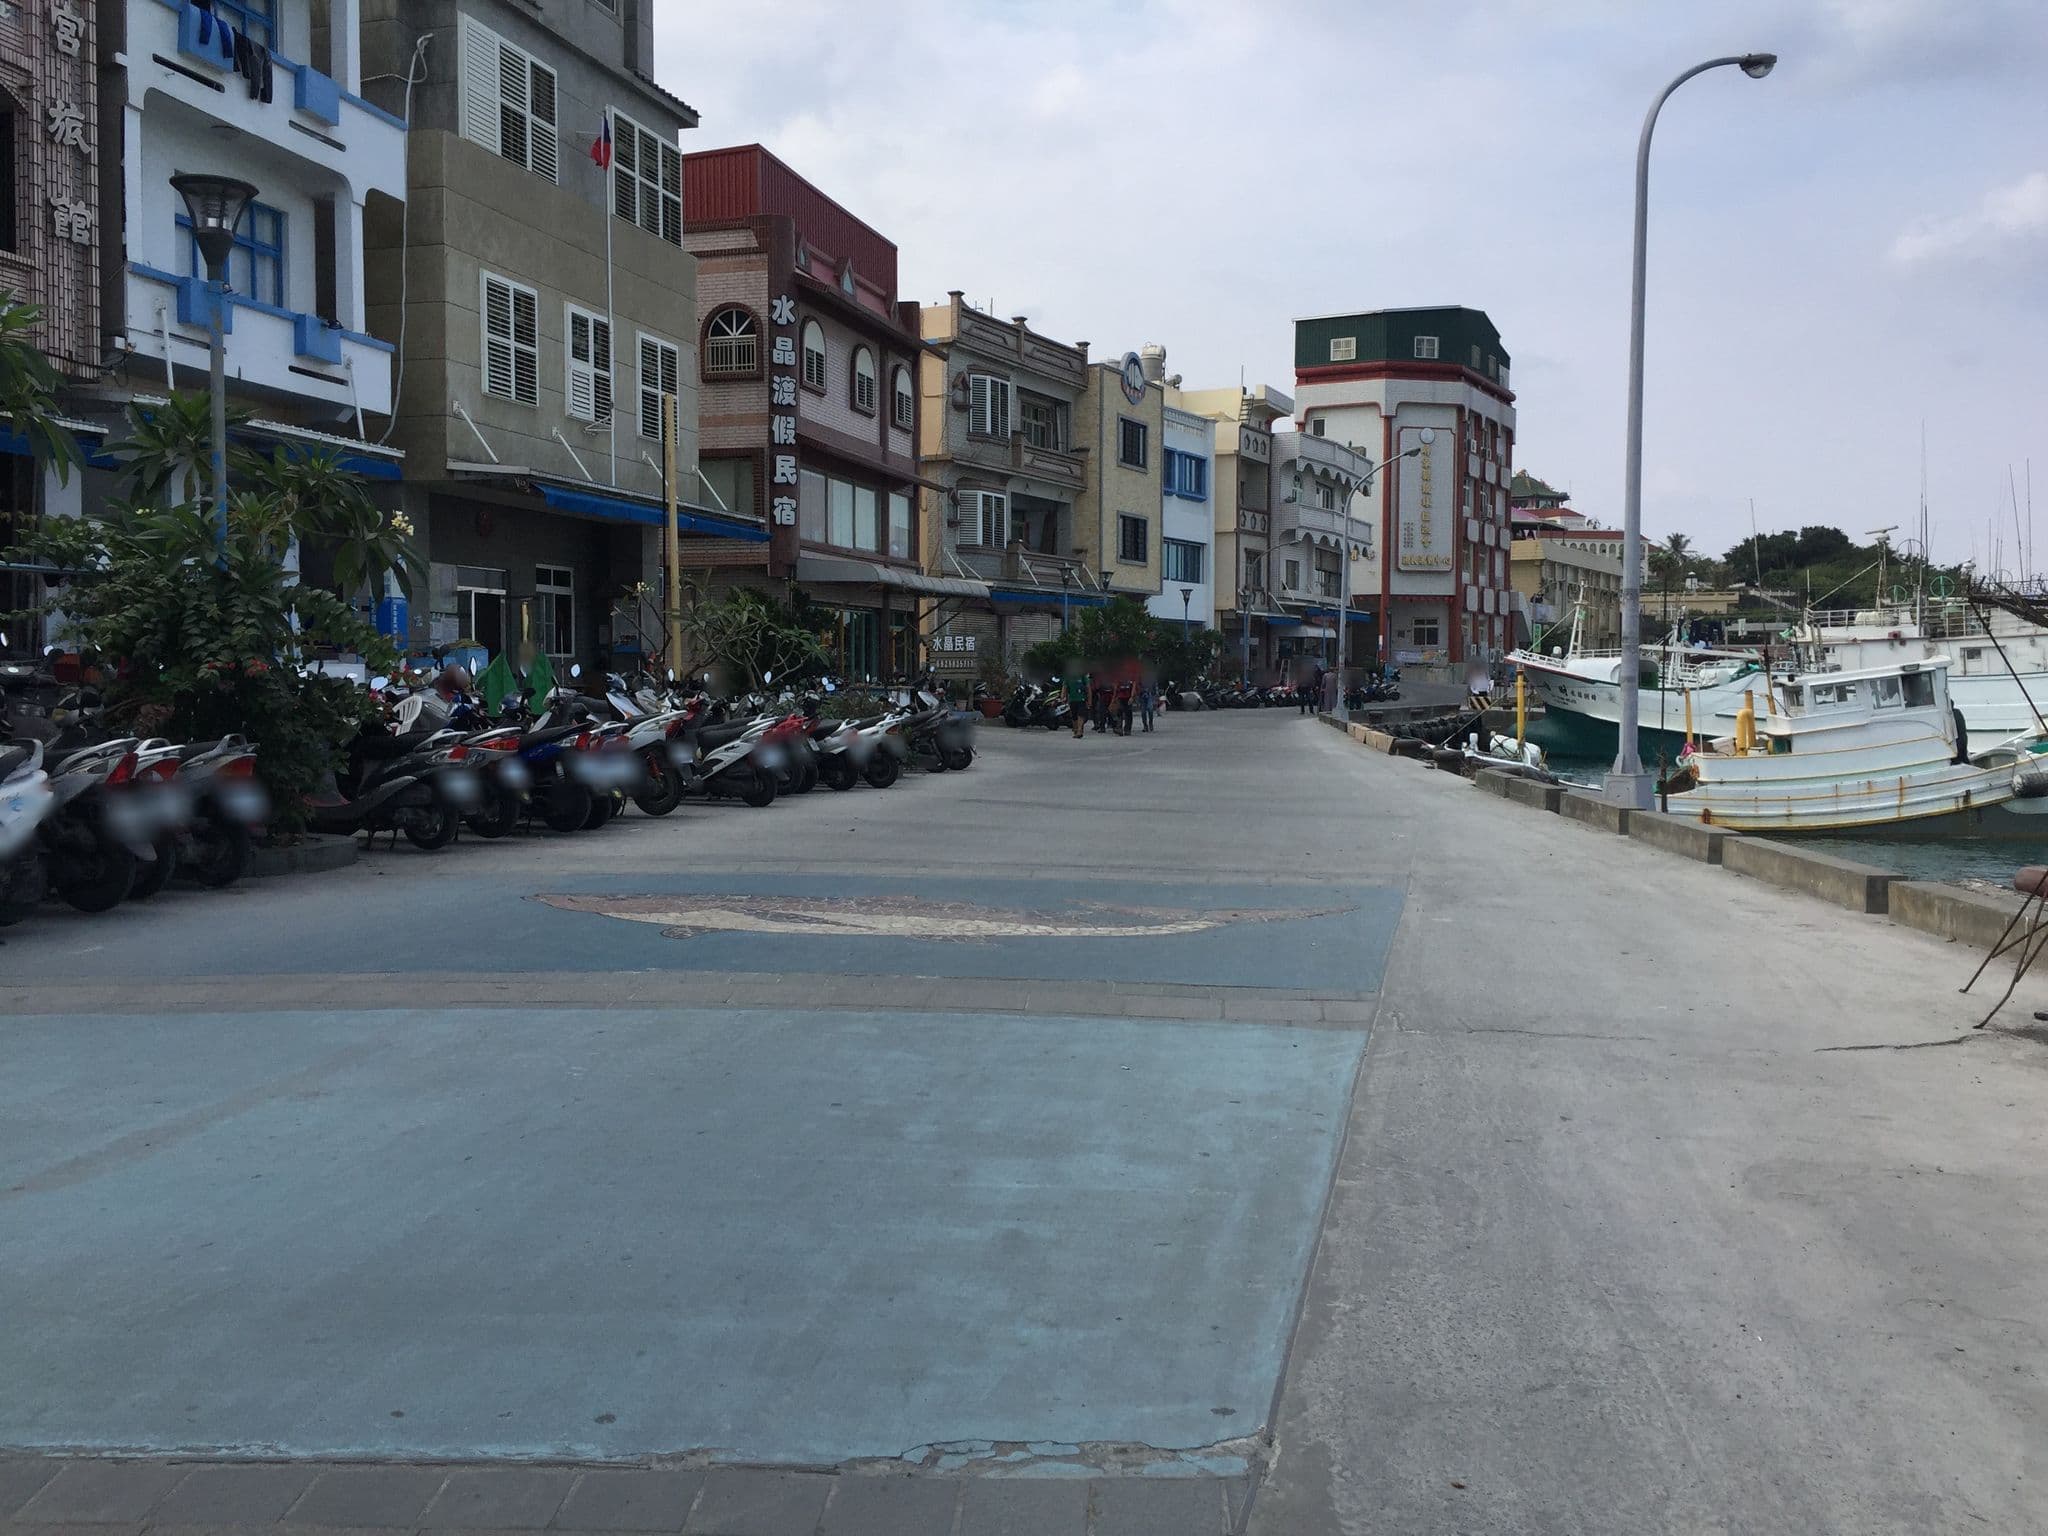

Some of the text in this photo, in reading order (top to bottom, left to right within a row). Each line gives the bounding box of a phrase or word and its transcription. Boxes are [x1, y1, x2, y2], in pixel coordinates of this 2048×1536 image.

[48, 0, 92, 246] 宮旅館
[771, 294, 797, 526] 水晶渡假民宿
[932, 636, 976, 651] 水晶民宿
